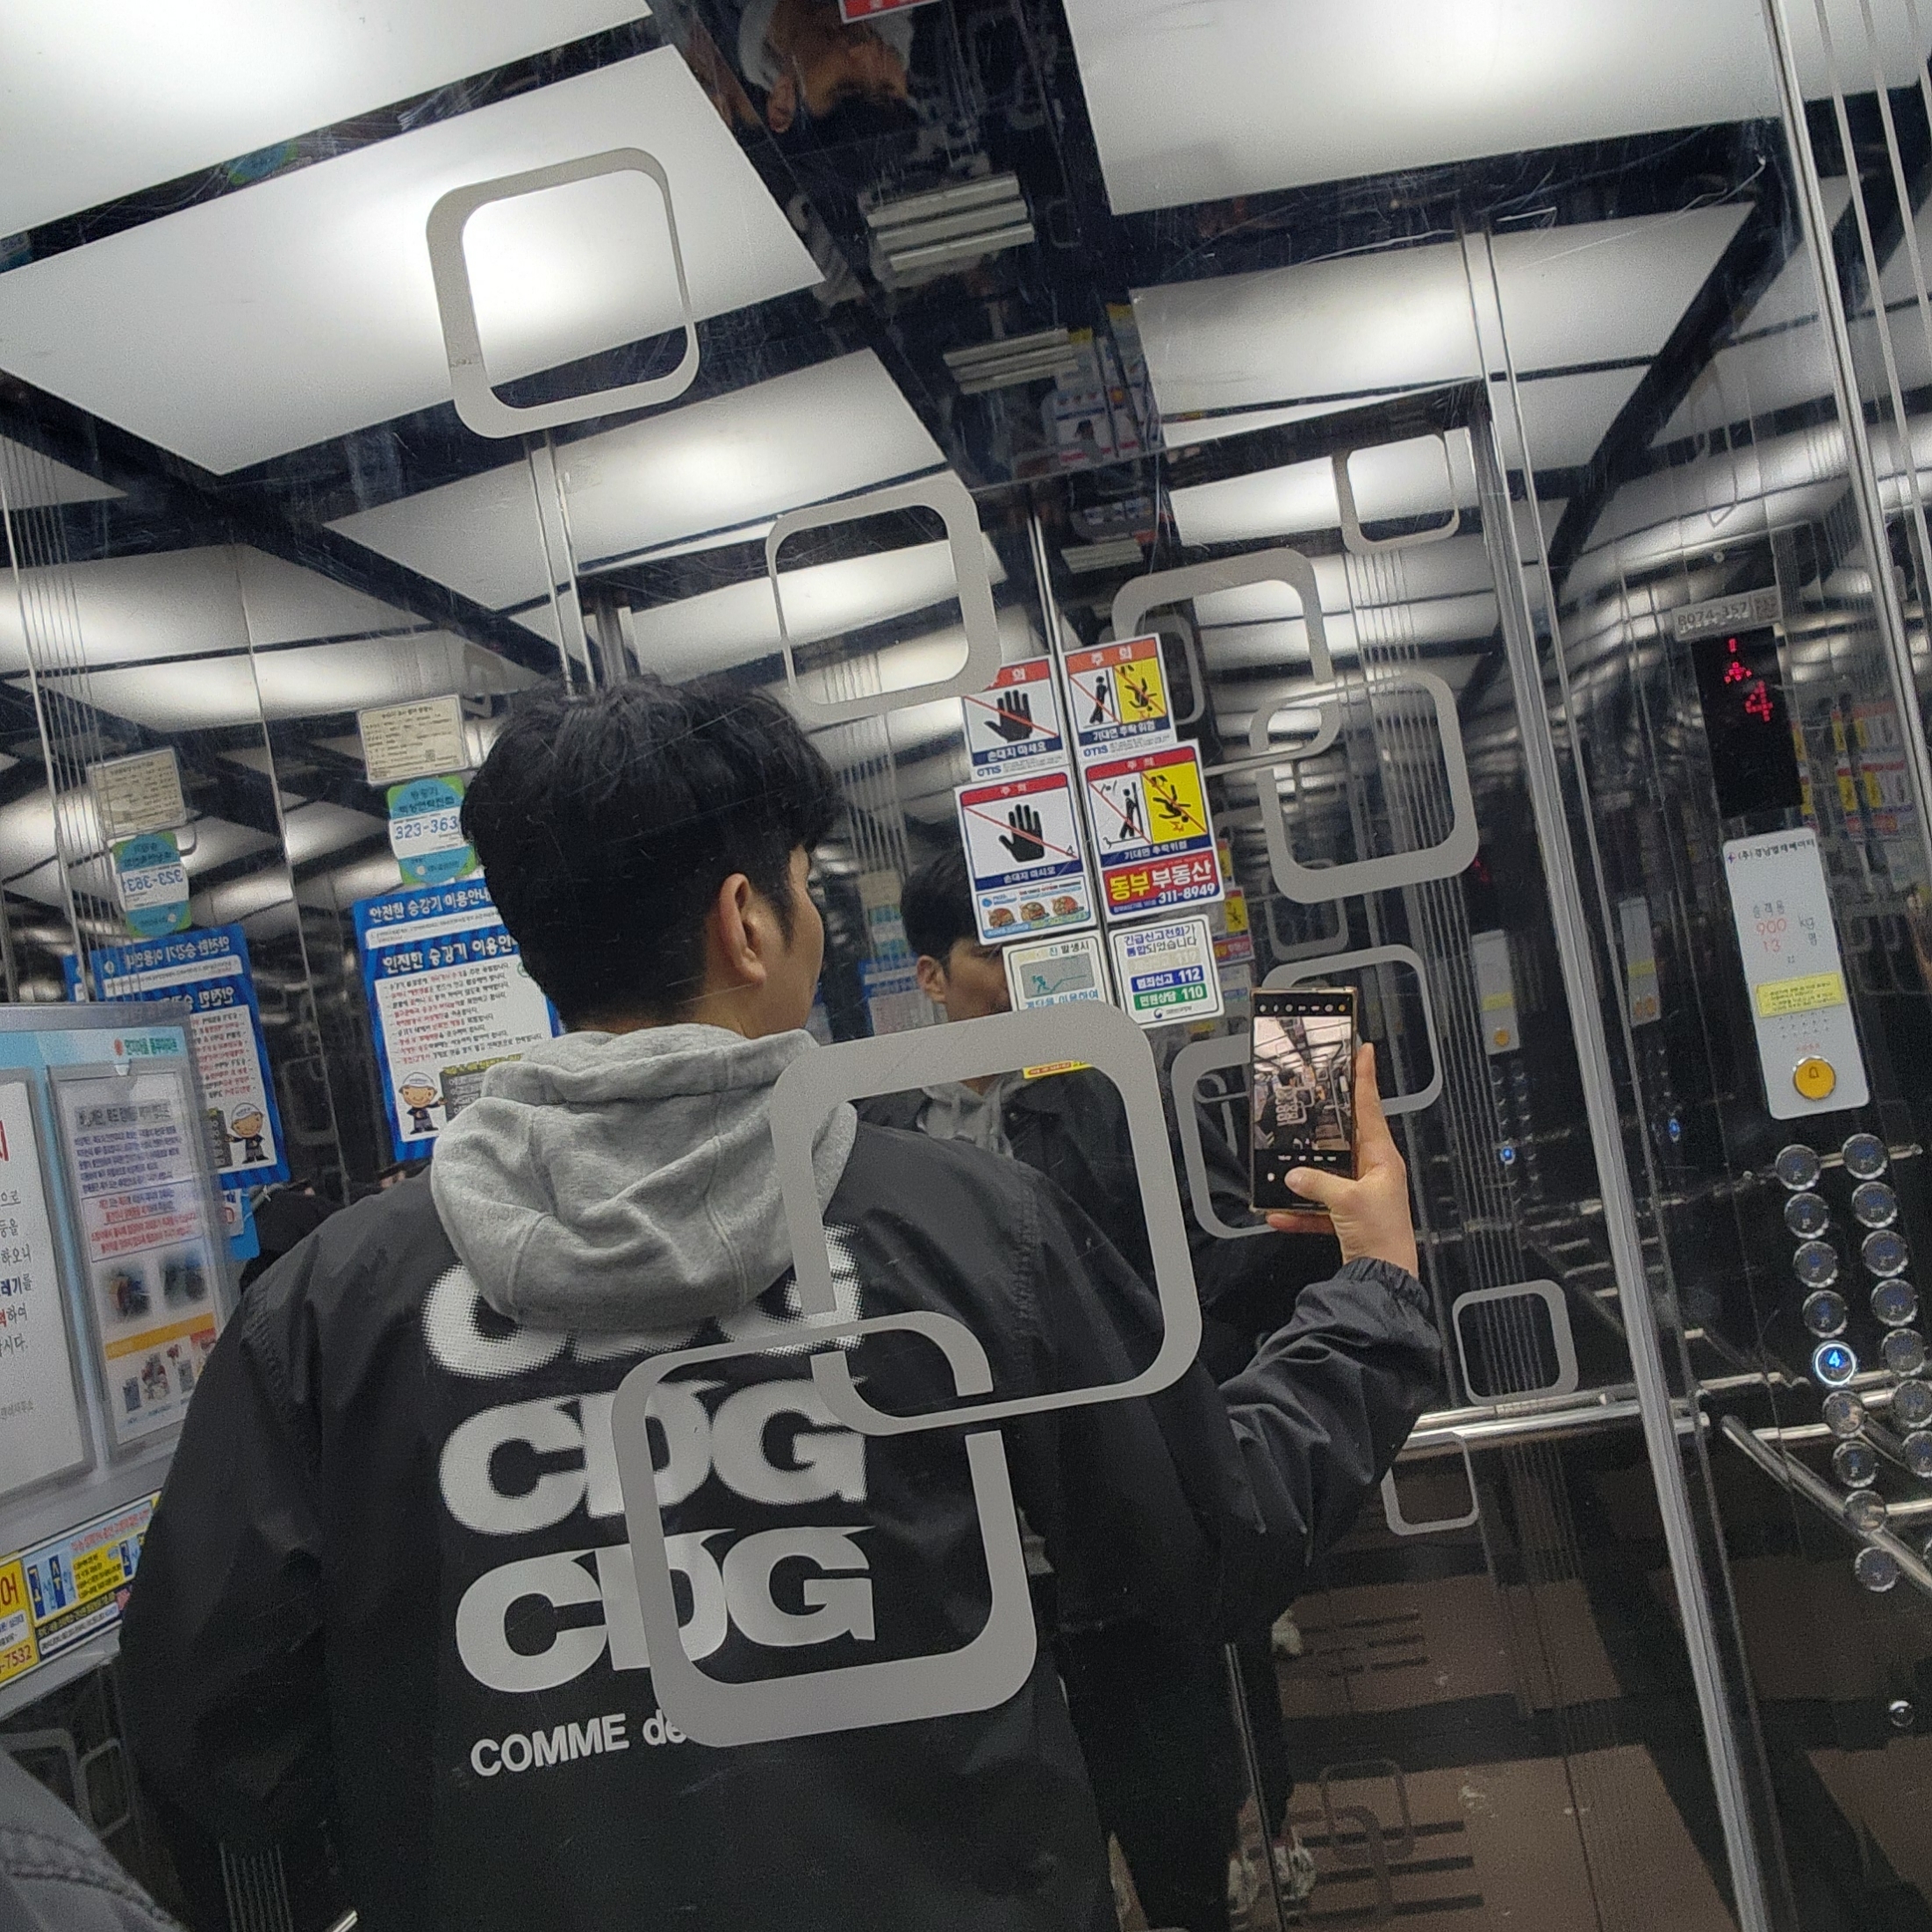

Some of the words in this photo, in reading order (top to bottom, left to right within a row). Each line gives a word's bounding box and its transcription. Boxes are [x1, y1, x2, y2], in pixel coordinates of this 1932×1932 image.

[1745, 680, 1773, 722] 4
[1083, 744, 1109, 758] OTIS
[976, 765, 1002, 778] OTIS
[395, 815, 458, 840] 323-363
[1110, 872, 1151, 901] 동부
[1152, 859, 1212, 889] 부동산
[1158, 882, 1216, 905] 311-8949
[369, 901, 406, 923] 안전한
[407, 894, 443, 917] 승강기
[1124, 924, 1196, 947] 긴급신고전화가
[1756, 917, 1787, 936] 900
[428, 942, 469, 966] 승강기
[1126, 936, 1198, 959] 통합되었습니다
[1763, 937, 1781, 953] 13
[1178, 966, 1202, 983] 112
[1181, 984, 1204, 1002] 110
[1, 1190, 21, 1208] 으로
[1, 1243, 32, 1267] 하오니
[0, 1273, 32, 1297] 레기를
[1829, 1351, 1840, 1366] 4
[439, 1375, 868, 1536] CDG
[455, 1525, 876, 1693] CDG
[470, 1713, 630, 1778] COMME
[643, 1708, 689, 1747] de
